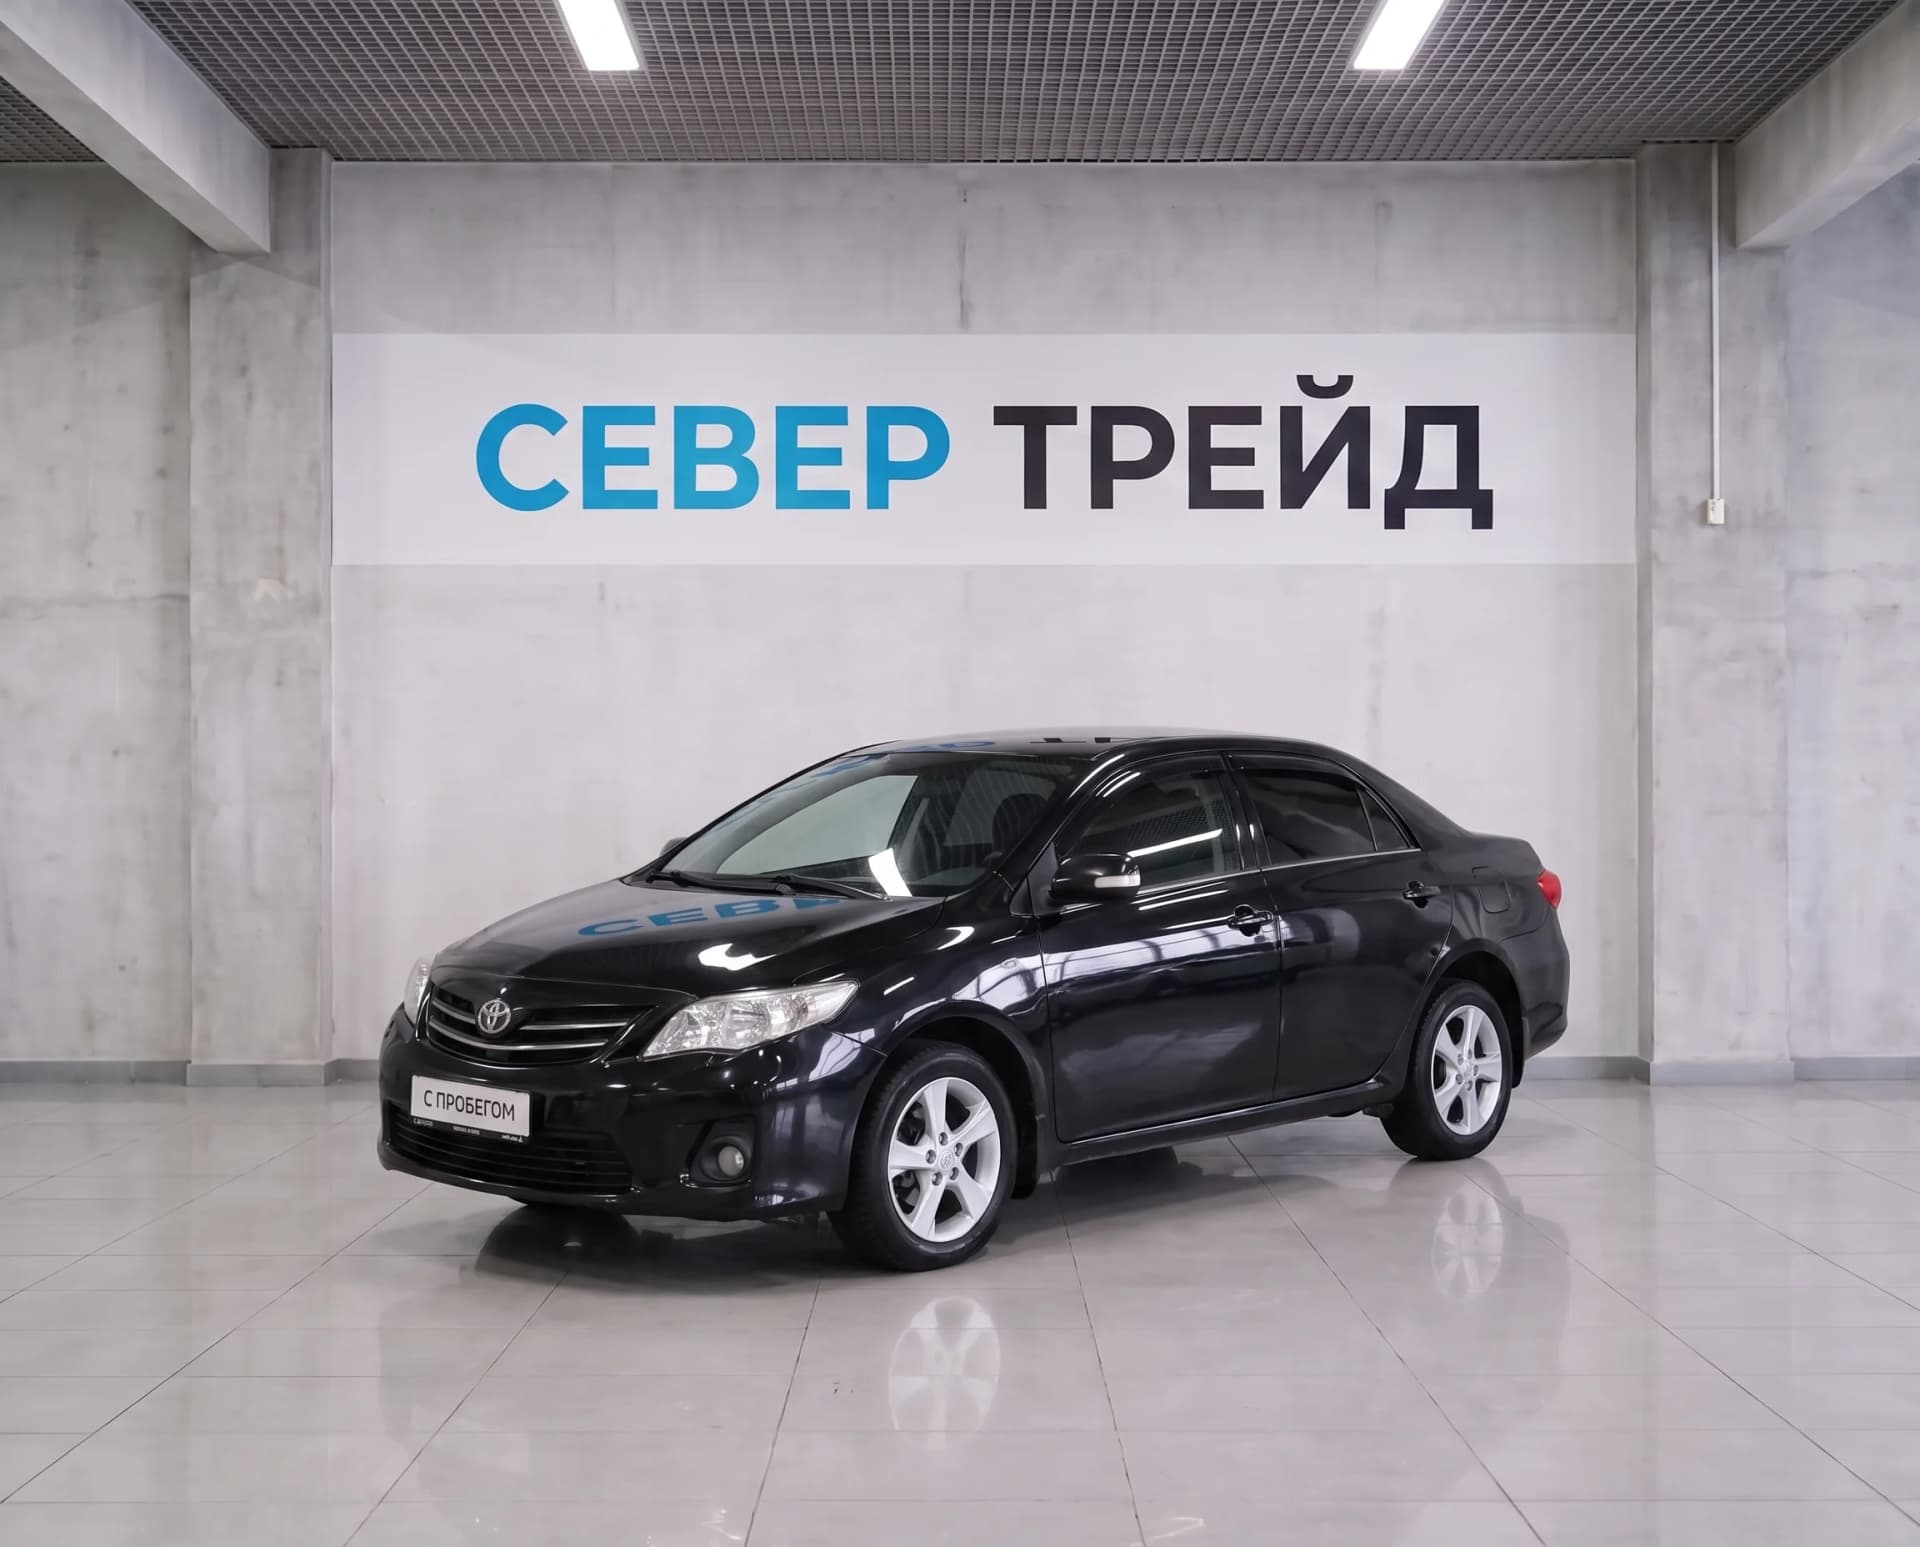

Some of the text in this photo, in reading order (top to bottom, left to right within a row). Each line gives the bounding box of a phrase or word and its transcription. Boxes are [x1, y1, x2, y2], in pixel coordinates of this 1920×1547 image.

[476, 375, 1493, 529] СЕВЕР ТРЕЙД
[424, 1090, 515, 1121] С ПРОБЕГОМ
